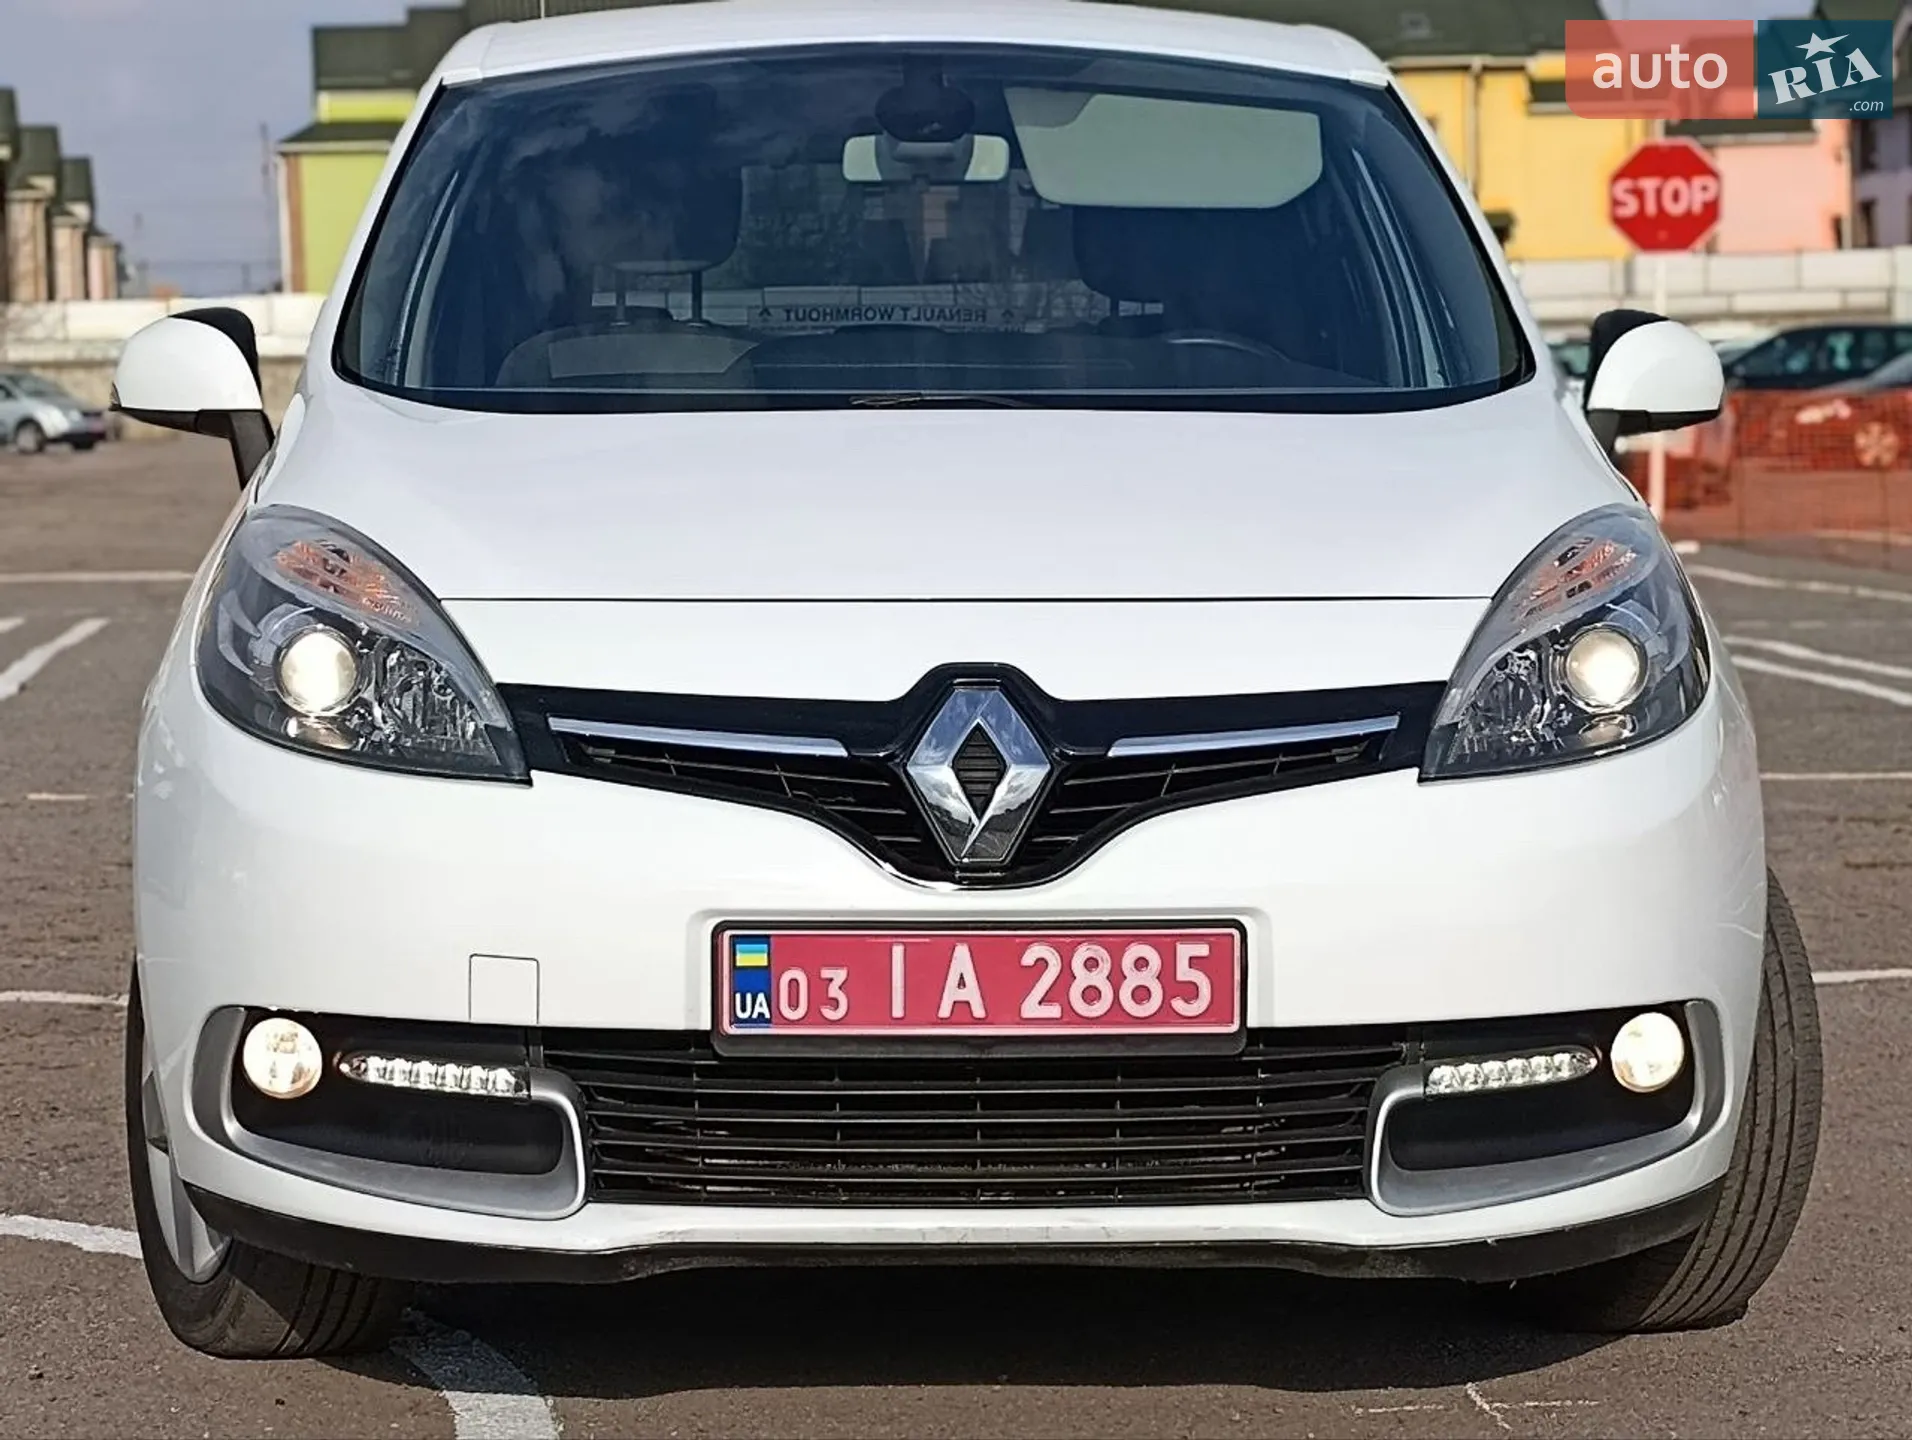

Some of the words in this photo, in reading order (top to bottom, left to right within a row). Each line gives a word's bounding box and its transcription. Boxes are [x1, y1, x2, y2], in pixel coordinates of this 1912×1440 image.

[1611, 174, 1719, 218] STOP
[778, 968, 850, 1021] 03
[1019, 941, 1213, 1019] 2885
[735, 992, 771, 1019] UA
